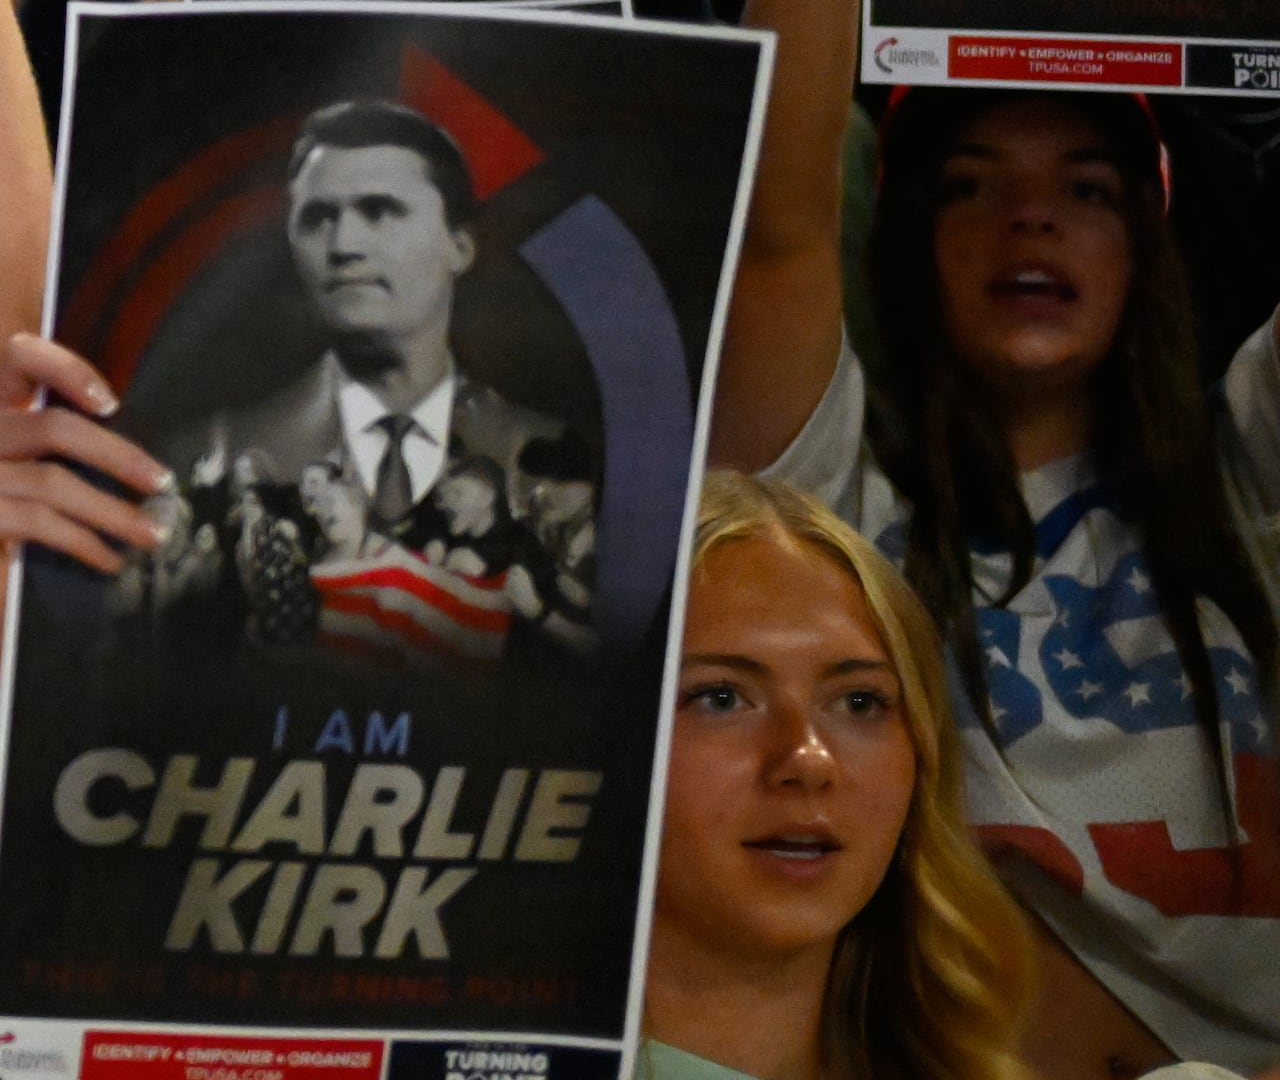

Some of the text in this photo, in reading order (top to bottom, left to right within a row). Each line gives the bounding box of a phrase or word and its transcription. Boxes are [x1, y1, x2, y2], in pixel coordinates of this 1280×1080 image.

[957, 44, 1173, 65] IDENTIFY EMPOWER ORGANIZE
[1234, 67, 1280, 89] POI
[272, 706, 413, 757] I AM
[53, 747, 603, 862] CHARLIE
[162, 857, 478, 961] KIRK
[445, 1051, 548, 1073] TURNING
